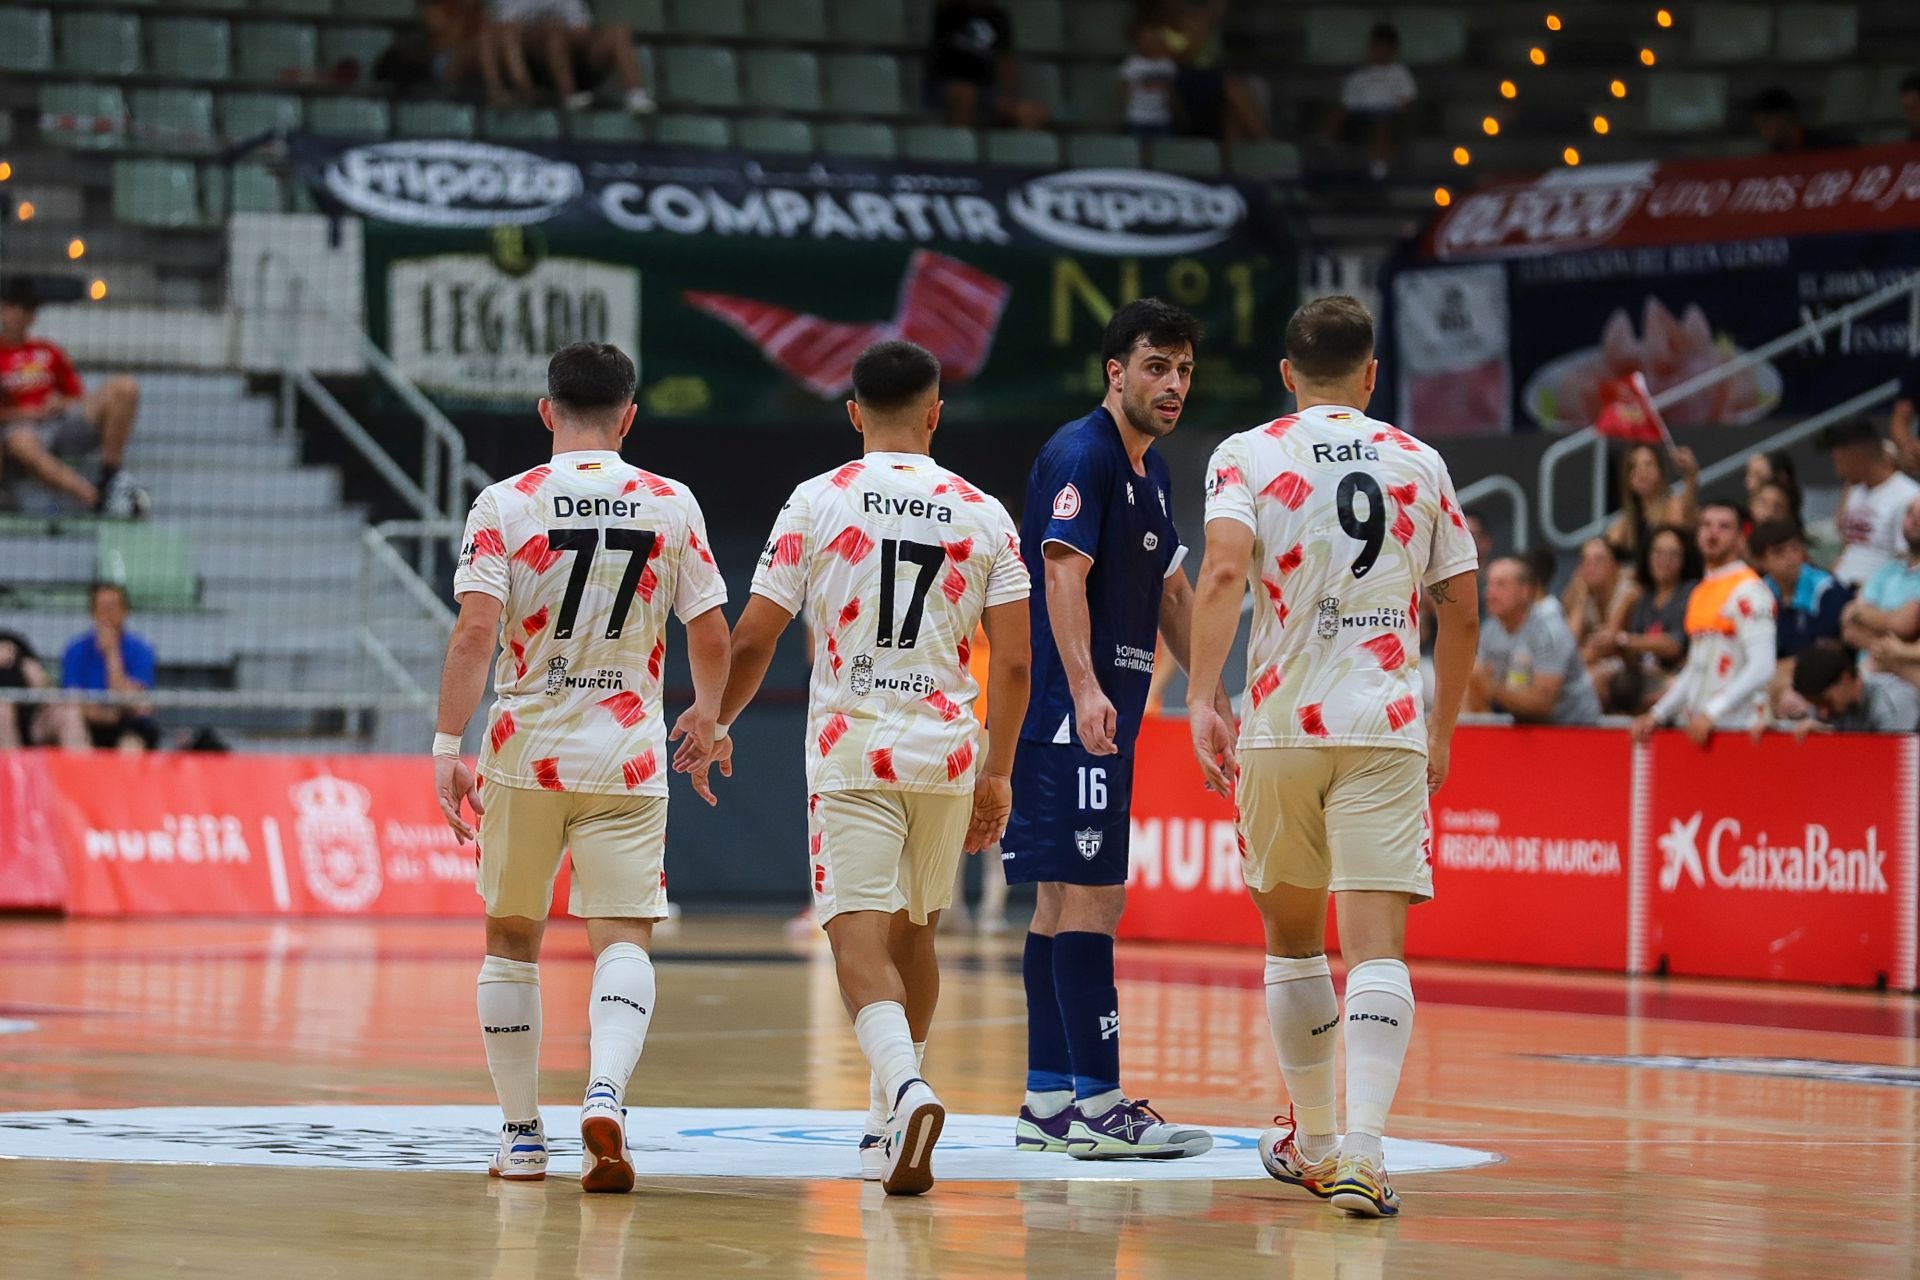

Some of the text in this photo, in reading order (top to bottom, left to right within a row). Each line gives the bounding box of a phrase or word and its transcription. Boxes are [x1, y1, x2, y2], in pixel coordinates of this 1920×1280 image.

[601, 181, 1011, 246] COMPARTIR
[420, 282, 609, 355] LEGADO
[1313, 439, 1380, 463] Rafa
[553, 496, 641, 519] Dener
[863, 492, 952, 523] Rivera
[1336, 471, 1386, 580] 9
[548, 528, 656, 640] 77
[876, 538, 947, 649] 17
[1342, 616, 1406, 629] MURCIA
[1377, 607, 1406, 618] 1200
[565, 677, 623, 690] MURCIA
[597, 669, 623, 678] 1200
[875, 679, 934, 695] MURCIA
[909, 673, 934, 685] 1200
[1077, 766, 1108, 810] 16
[85, 827, 251, 864] MURCIA
[1128, 817, 1243, 894] MUR
[1515, 837, 1541, 872] DE
[1545, 840, 1621, 875] MURCIA
[1707, 817, 1888, 893] CaixaBank
[601, 994, 647, 1015] ELPOZO
[484, 1024, 530, 1034] ELPOZO
[1349, 1013, 1398, 1027] ELPOZO
